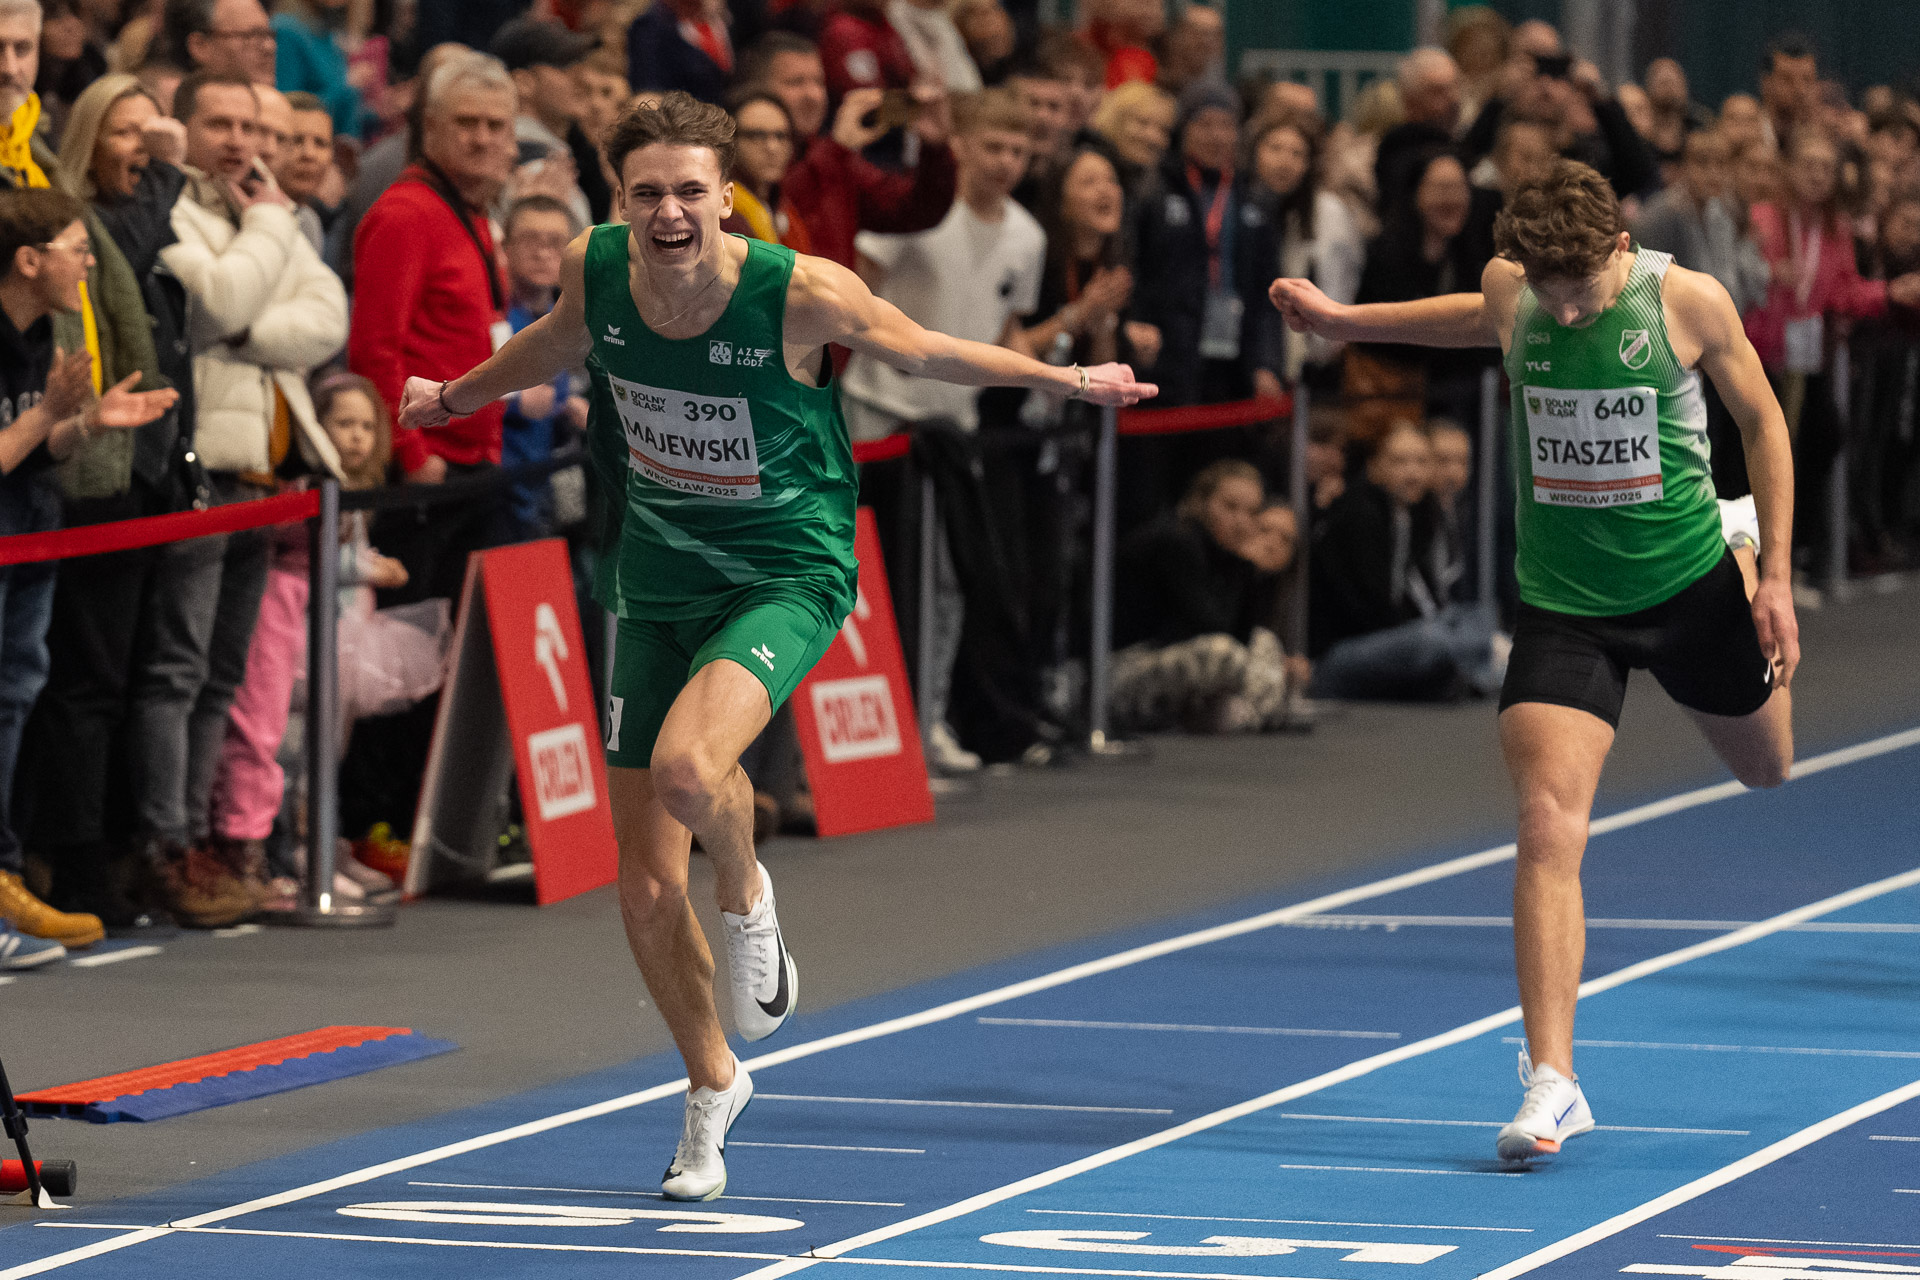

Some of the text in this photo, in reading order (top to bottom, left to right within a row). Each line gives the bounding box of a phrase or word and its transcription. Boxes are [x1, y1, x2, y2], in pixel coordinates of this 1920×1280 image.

[603, 335, 625, 346] erima
[631, 390, 666, 405] DOLNY
[1545, 398, 1578, 408] DOLNY
[1594, 395, 1645, 420] 640
[683, 400, 737, 422] 390
[623, 414, 750, 462] MAJEWSKI
[1536, 435, 1651, 465] STASZEK
[644, 467, 738, 497] WROCŁAW 2025
[702, 475, 723, 483] Polski
[1550, 491, 1642, 504] WROCŁAW 2025
[751, 646, 775, 672] erima
